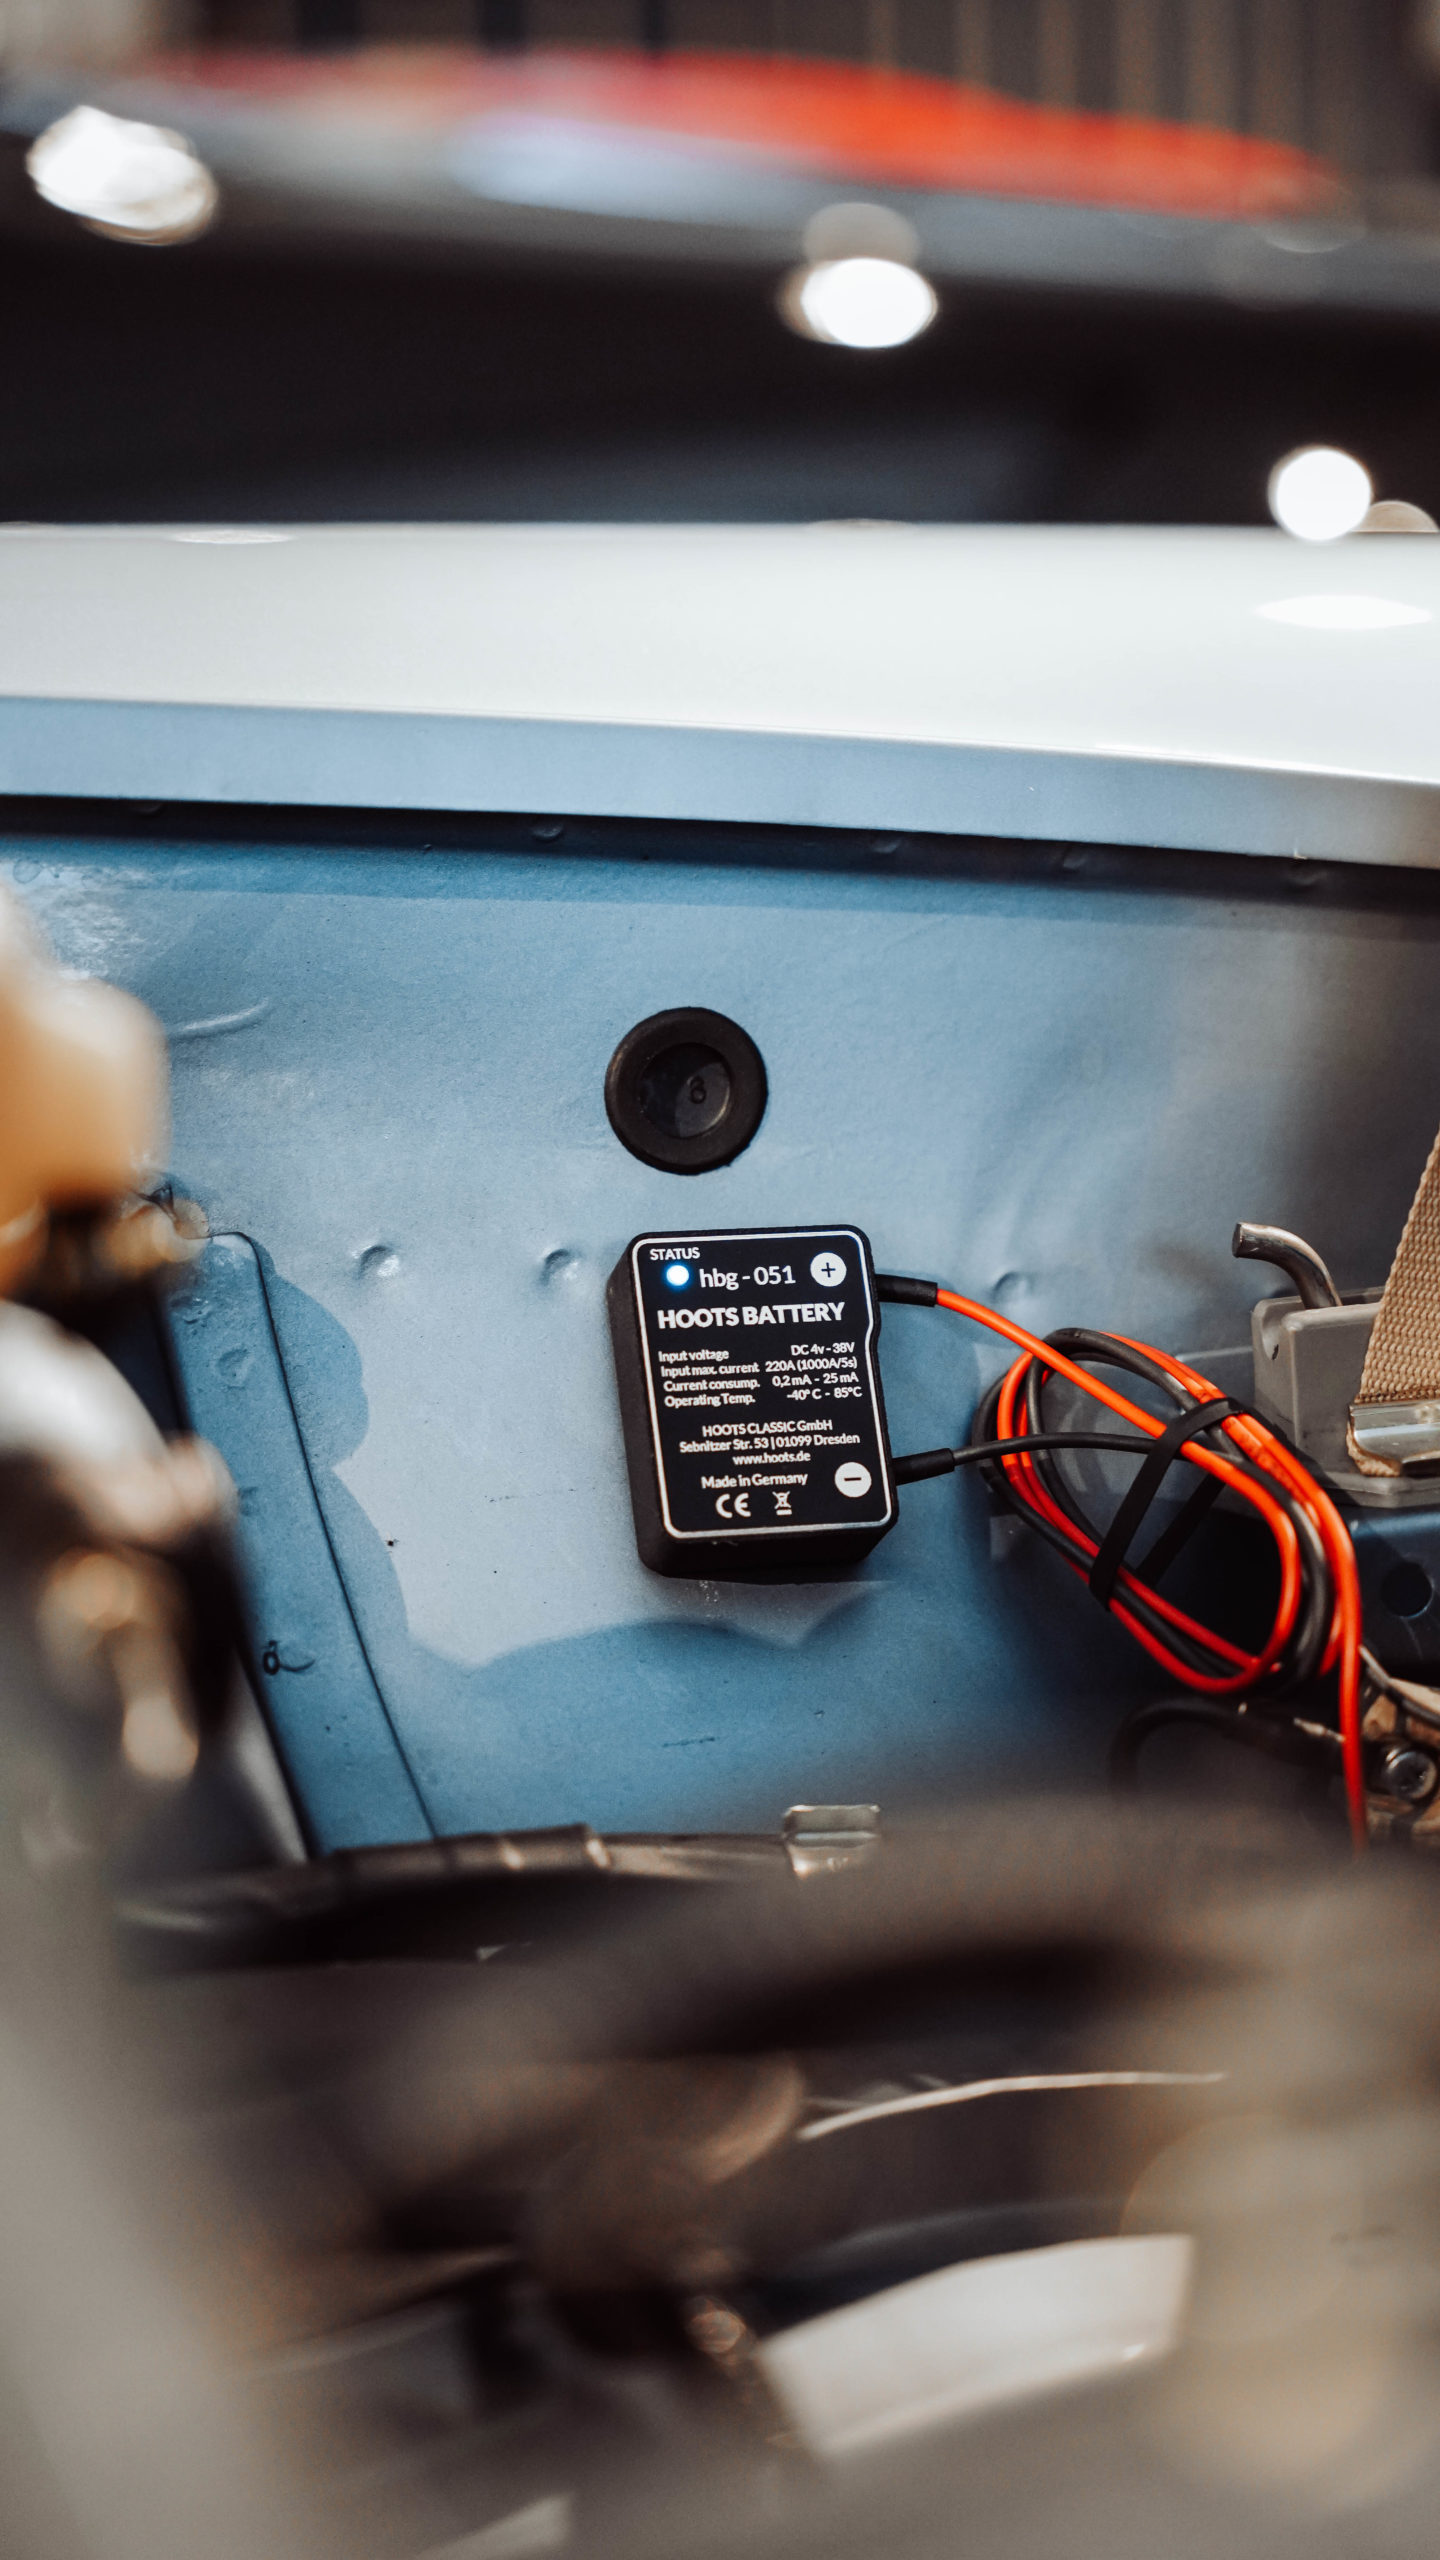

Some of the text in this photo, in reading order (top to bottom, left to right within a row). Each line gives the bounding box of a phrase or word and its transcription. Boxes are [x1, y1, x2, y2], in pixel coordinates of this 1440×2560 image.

[650, 1247, 700, 1260] STATUS
[657, 1302, 845, 1329] HOOTS BATTERY
[658, 1349, 729, 1364] Input voltage
[791, 1344, 809, 1356] DC
[660, 1362, 760, 1379] Input max. current
[765, 1356, 858, 1373] 220A (1000A/5s)
[663, 1378, 760, 1392] Current consump.
[664, 1393, 756, 1409] Operating Temp.
[702, 1419, 832, 1438] HOOTS CLASSIC GmbH
[679, 1440, 732, 1453] Sebnitzer
[733, 1438, 753, 1450] Str.
[754, 1437, 769, 1448] 53
[813, 1433, 860, 1445] Dresden
[732, 1450, 811, 1466] www.hoots.de
[701, 1473, 808, 1489] Made in Germany
